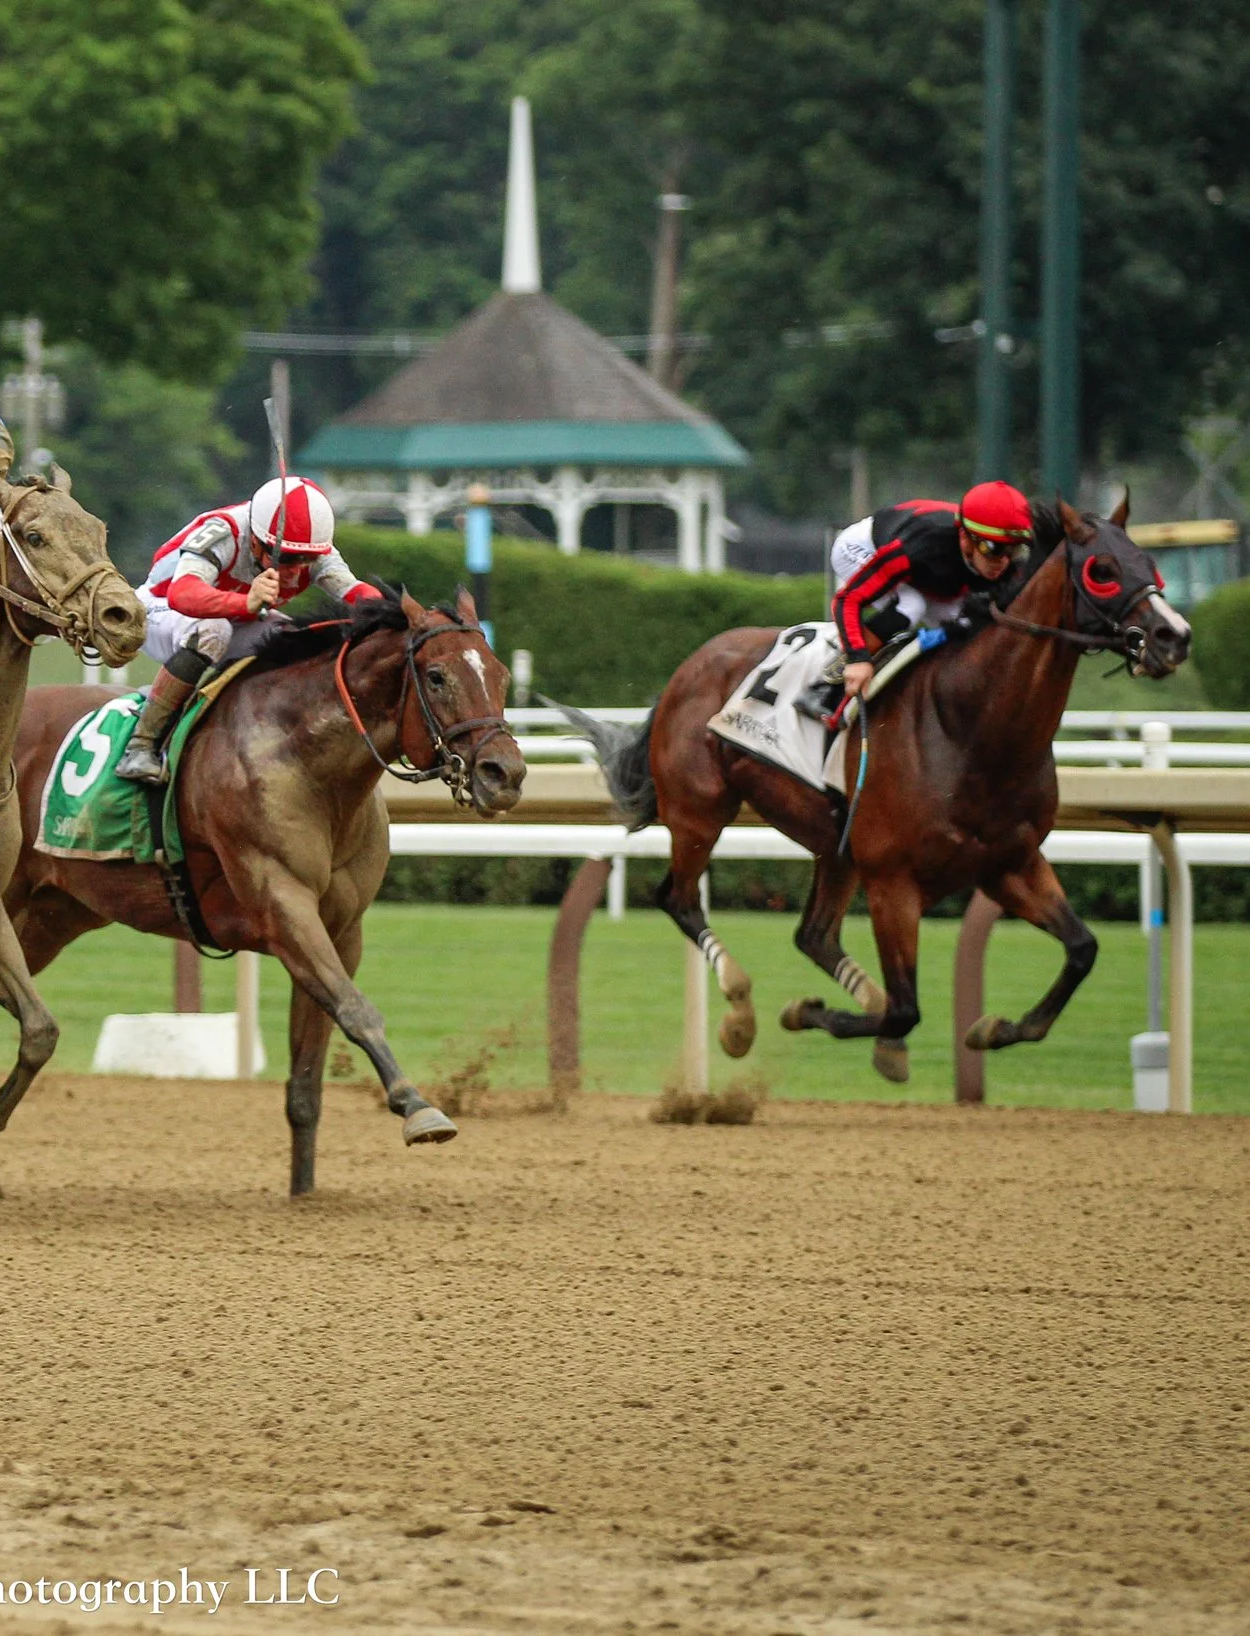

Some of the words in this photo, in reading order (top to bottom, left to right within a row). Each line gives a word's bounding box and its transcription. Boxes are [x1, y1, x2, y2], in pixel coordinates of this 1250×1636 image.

[187, 523, 229, 549] 5
[741, 628, 817, 706] 2
[60, 698, 141, 797] 5
